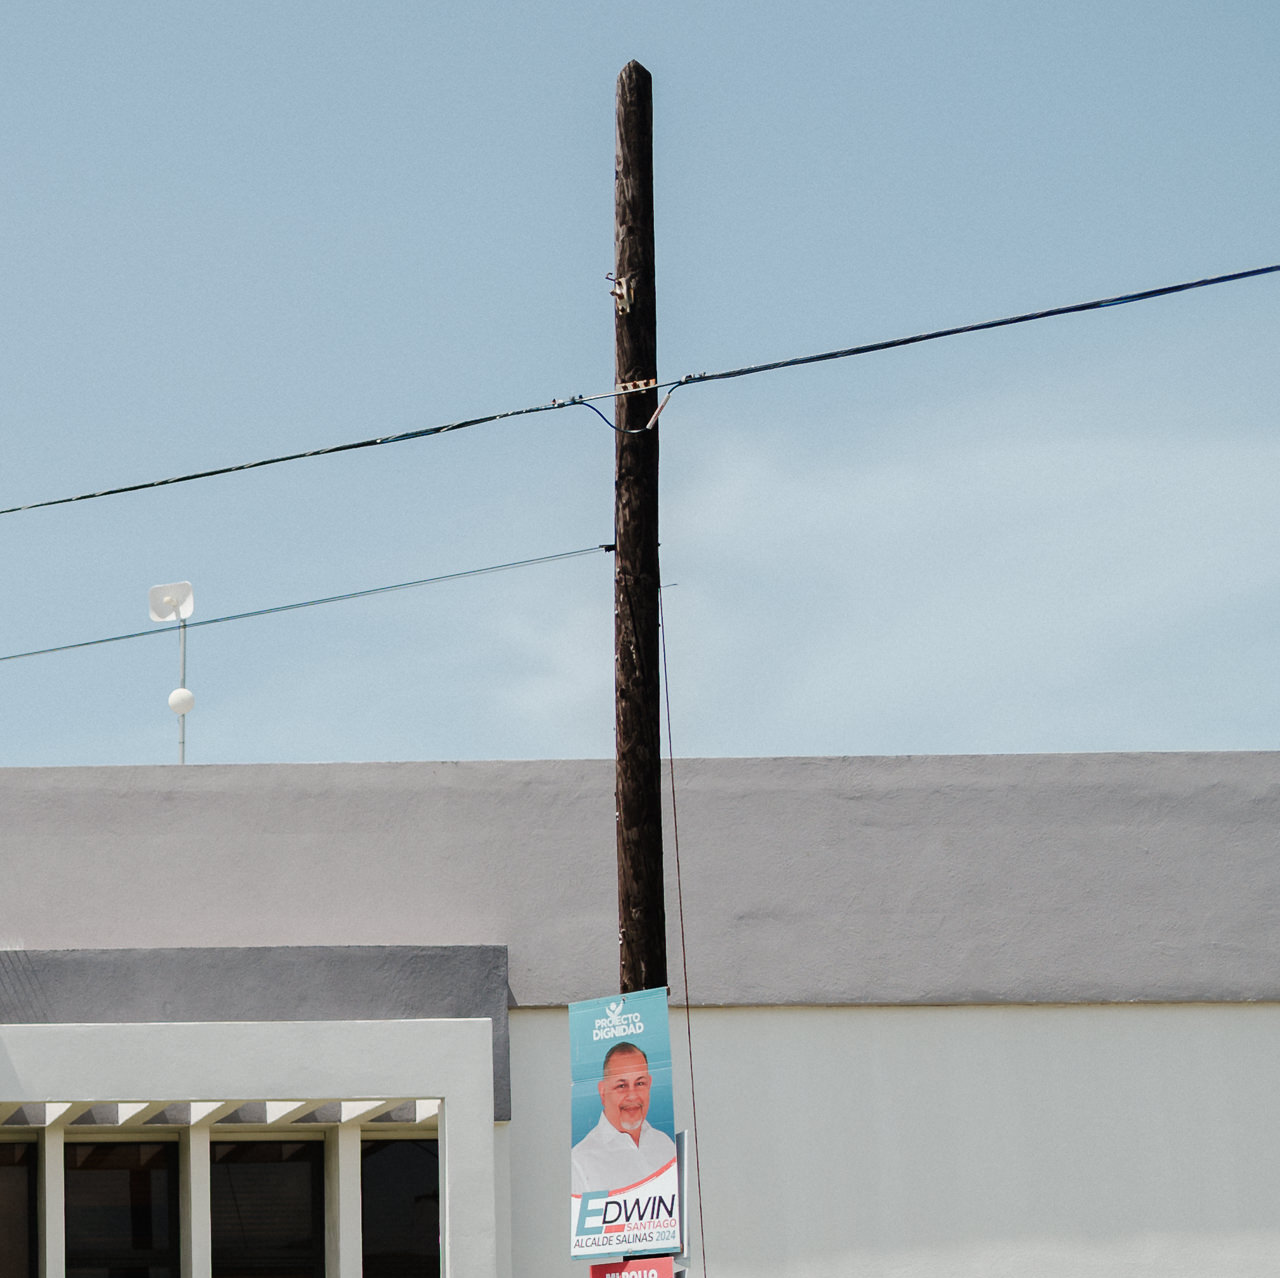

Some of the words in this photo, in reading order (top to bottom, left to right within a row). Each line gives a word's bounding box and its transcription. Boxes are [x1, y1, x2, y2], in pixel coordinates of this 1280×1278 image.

[593, 1022, 644, 1040] DIGNIDAD
[576, 1190, 676, 1237] EDWIN
[626, 1218, 677, 1232] SANTIAGO
[573, 1235, 614, 1249] ALCALDE
[615, 1231, 654, 1246] SALINAS
[655, 1230, 677, 1242] 2024
